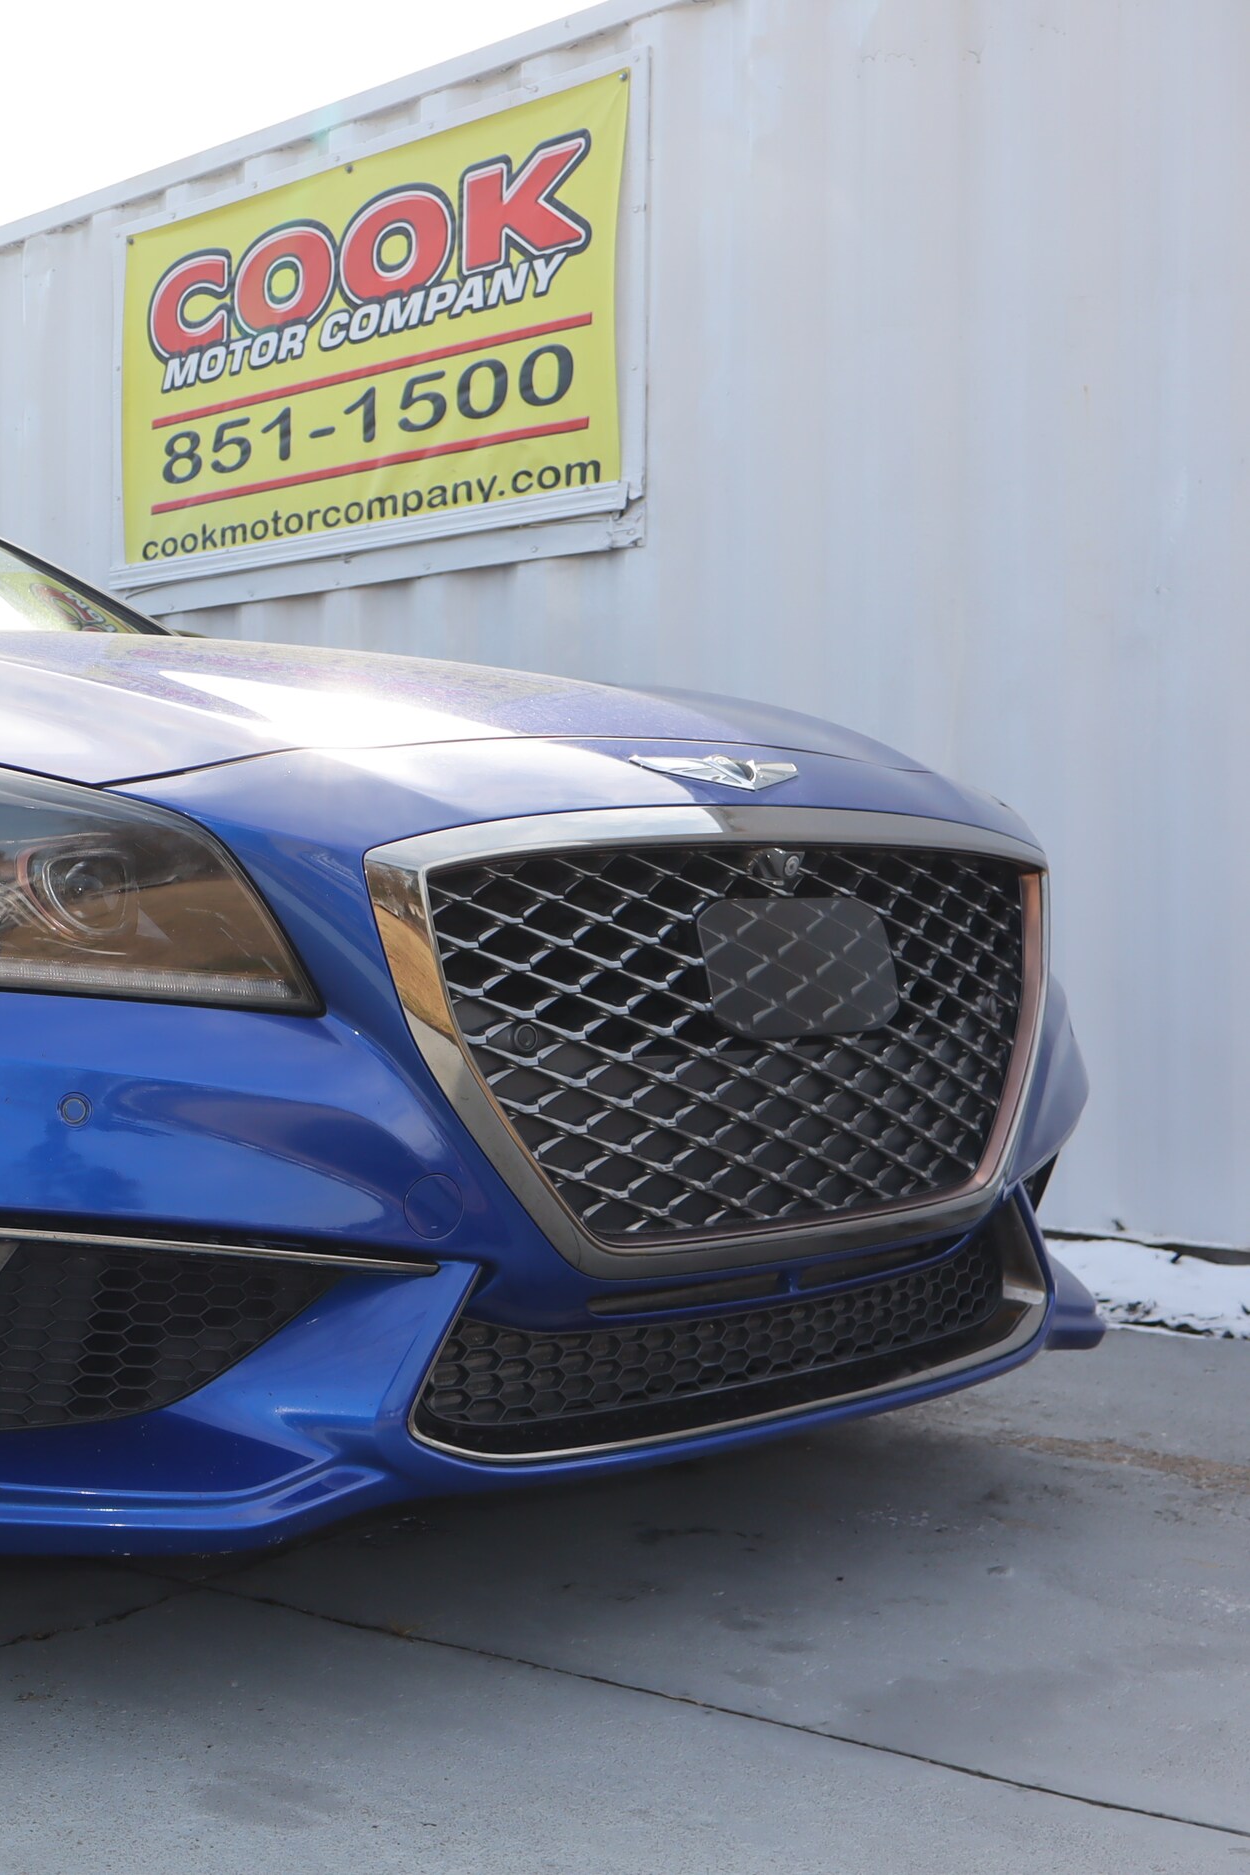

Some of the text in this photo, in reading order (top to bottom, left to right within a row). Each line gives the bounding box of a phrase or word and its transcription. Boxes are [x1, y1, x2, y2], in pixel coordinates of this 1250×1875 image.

[149, 130, 591, 358] COOK
[162, 252, 569, 392] MOTOR COMPANY
[162, 344, 574, 484] 851-1500
[141, 459, 602, 560] cookmotorcompany.com
